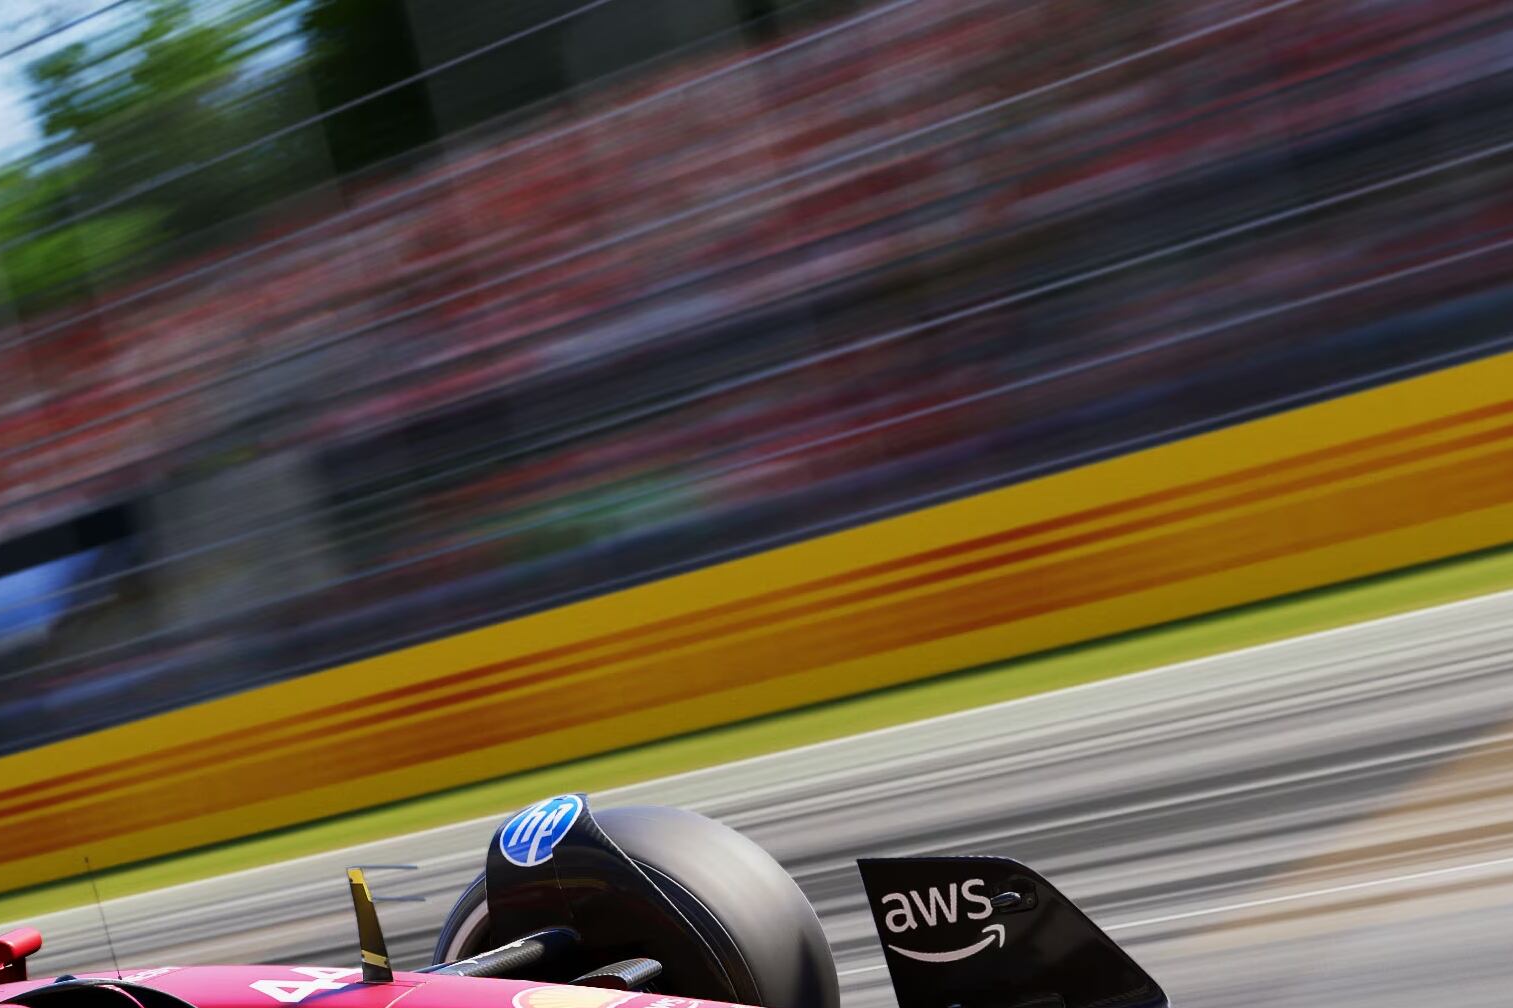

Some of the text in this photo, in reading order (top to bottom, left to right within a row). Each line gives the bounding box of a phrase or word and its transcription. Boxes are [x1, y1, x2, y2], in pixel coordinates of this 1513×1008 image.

[508, 800, 575, 865] hp
[881, 878, 994, 933] aws
[248, 966, 363, 1003] 44
